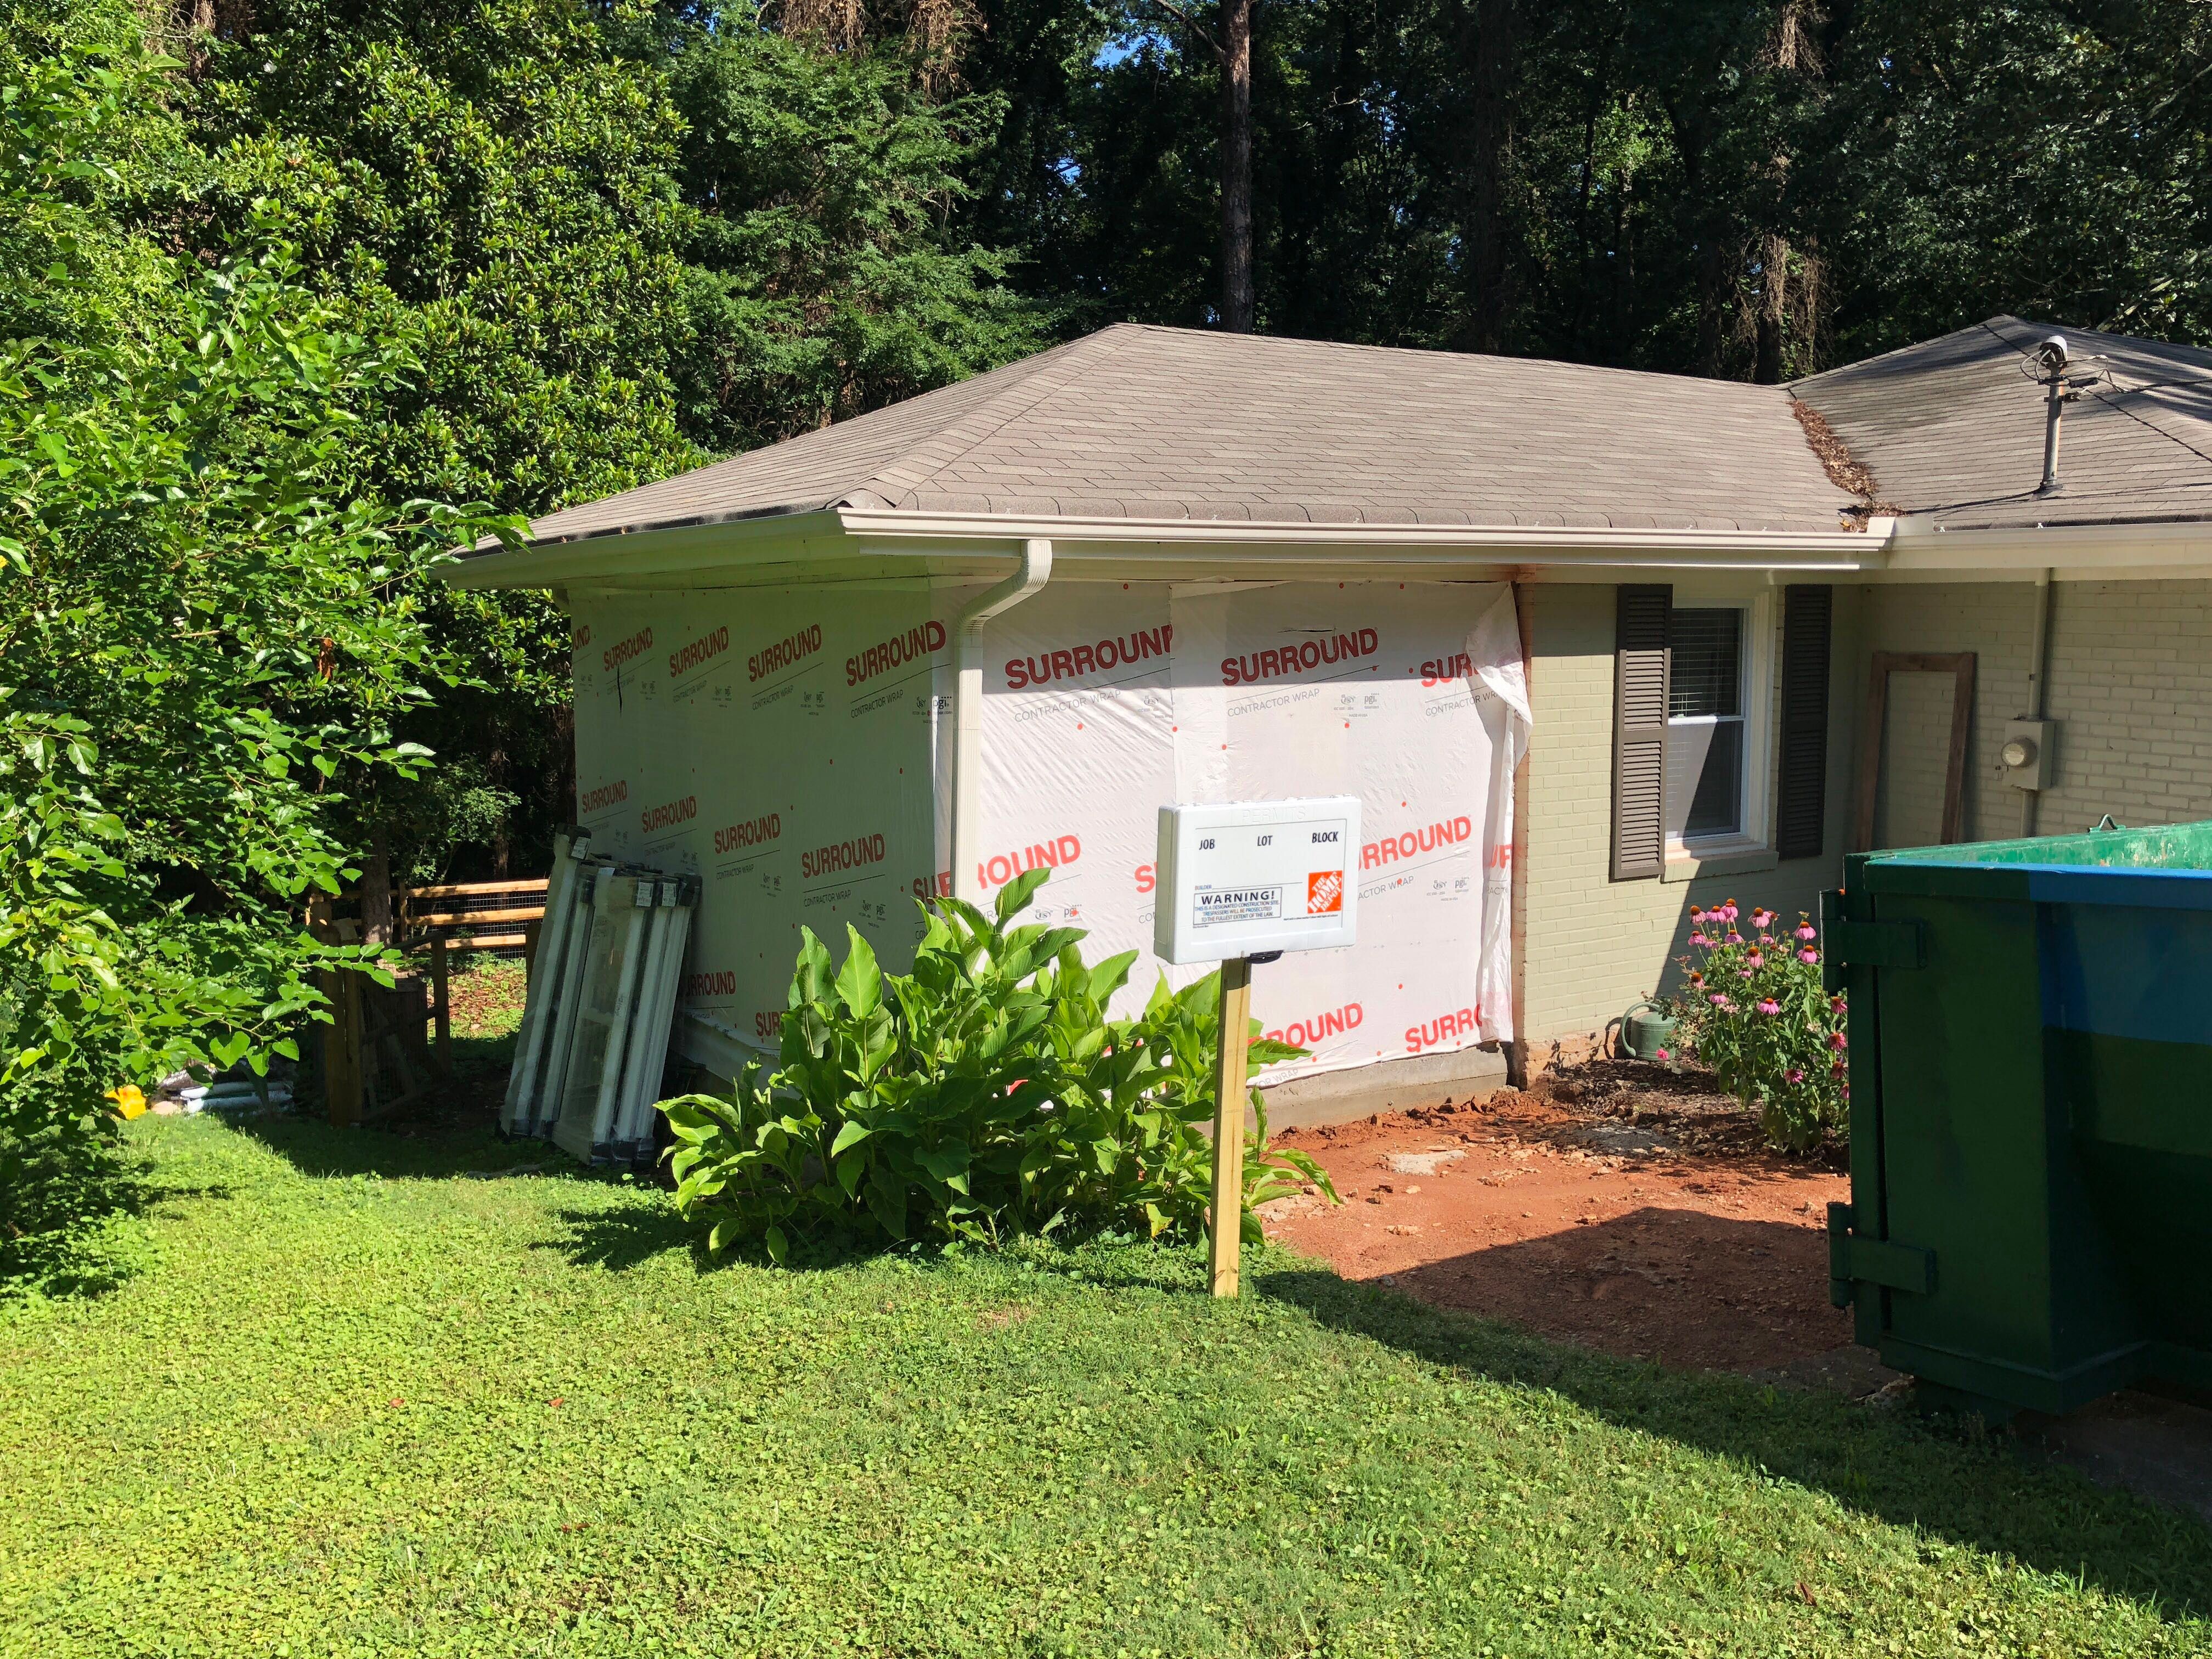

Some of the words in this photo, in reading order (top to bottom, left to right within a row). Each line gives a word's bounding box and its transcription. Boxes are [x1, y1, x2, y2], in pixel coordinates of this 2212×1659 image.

[603, 627, 653, 672] SURROUND
[669, 625, 729, 678] SURROUND
[748, 624, 822, 682] SURROUND
[845, 620, 946, 686] SURROUND
[1221, 628, 1378, 686] SURROUND
[752, 691, 780, 710] CONTRACTOR
[781, 685, 794, 697] WRAP
[851, 697, 886, 719] CONTRACTOR
[887, 689, 904, 703] WRAP
[1014, 697, 1087, 723] CONTRACTOR
[1090, 690, 1121, 703] WRAP
[1227, 696, 1290, 717] CONTRACTOR
[1292, 688, 1320, 702] WRAP
[1426, 695, 1481, 717] CONTRACTOR
[1483, 690, 1499, 701] WR
[582, 780, 628, 814] SURROUND
[641, 795, 697, 833] SURROUND
[714, 813, 781, 854] SURROUND
[1199, 839, 1215, 850] JOB
[1257, 835, 1273, 846] LOT
[1312, 831, 1339, 843] BLOCK
[1358, 816, 1471, 873] RROUND
[802, 833, 885, 878] SURROUND
[804, 893, 836, 907] CONTRACTOR
[836, 889, 851, 900] WRAP
[1201, 890, 1275, 905] WARNING!
[1307, 871, 1341, 913] HOME
[1312, 875, 1328, 893] THE
[1320, 884, 1342, 911] DEPOT
[685, 971, 736, 996] URROUND
[1273, 1068, 1299, 1082] WRAP
